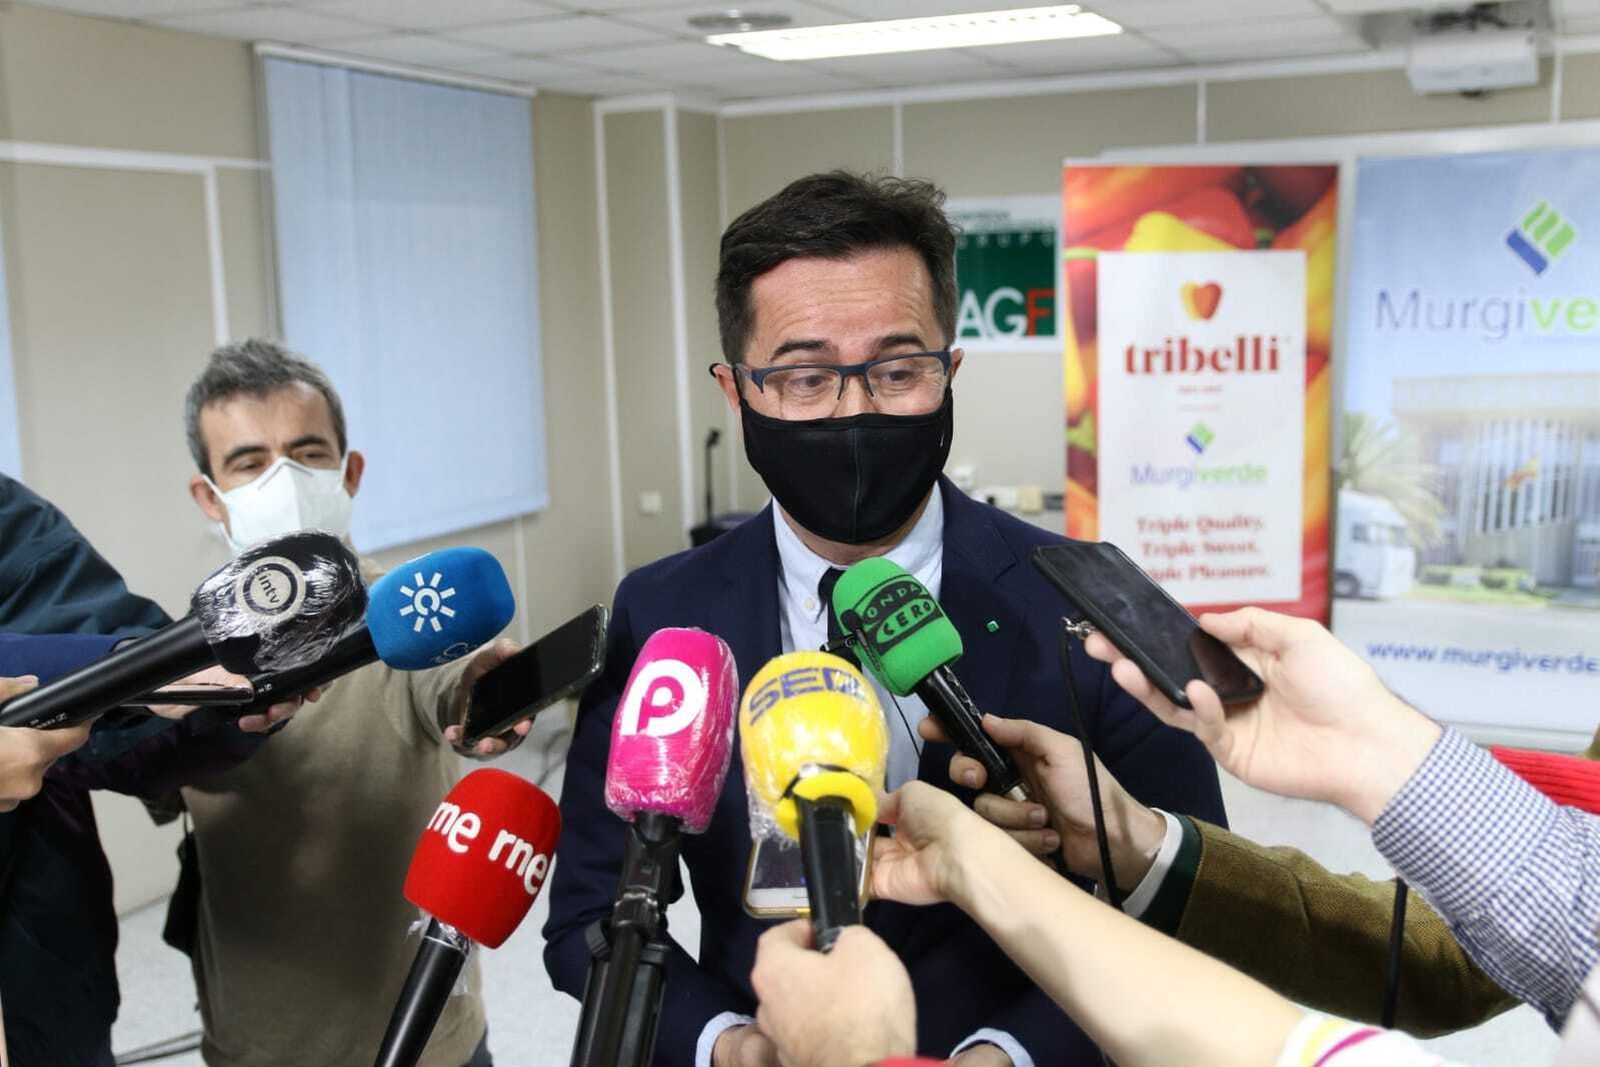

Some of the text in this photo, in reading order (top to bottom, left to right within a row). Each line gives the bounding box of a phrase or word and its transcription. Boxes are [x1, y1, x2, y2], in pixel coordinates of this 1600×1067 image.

[1125, 335, 1279, 374] tribelli
[1131, 464, 1268, 488] Murgiverde
[1137, 517, 1189, 534] Triple
[1143, 543, 1195, 558] Triple
[866, 582, 923, 619] ONDA
[883, 601, 933, 636] CERO
[488, 829, 548, 895] rne
